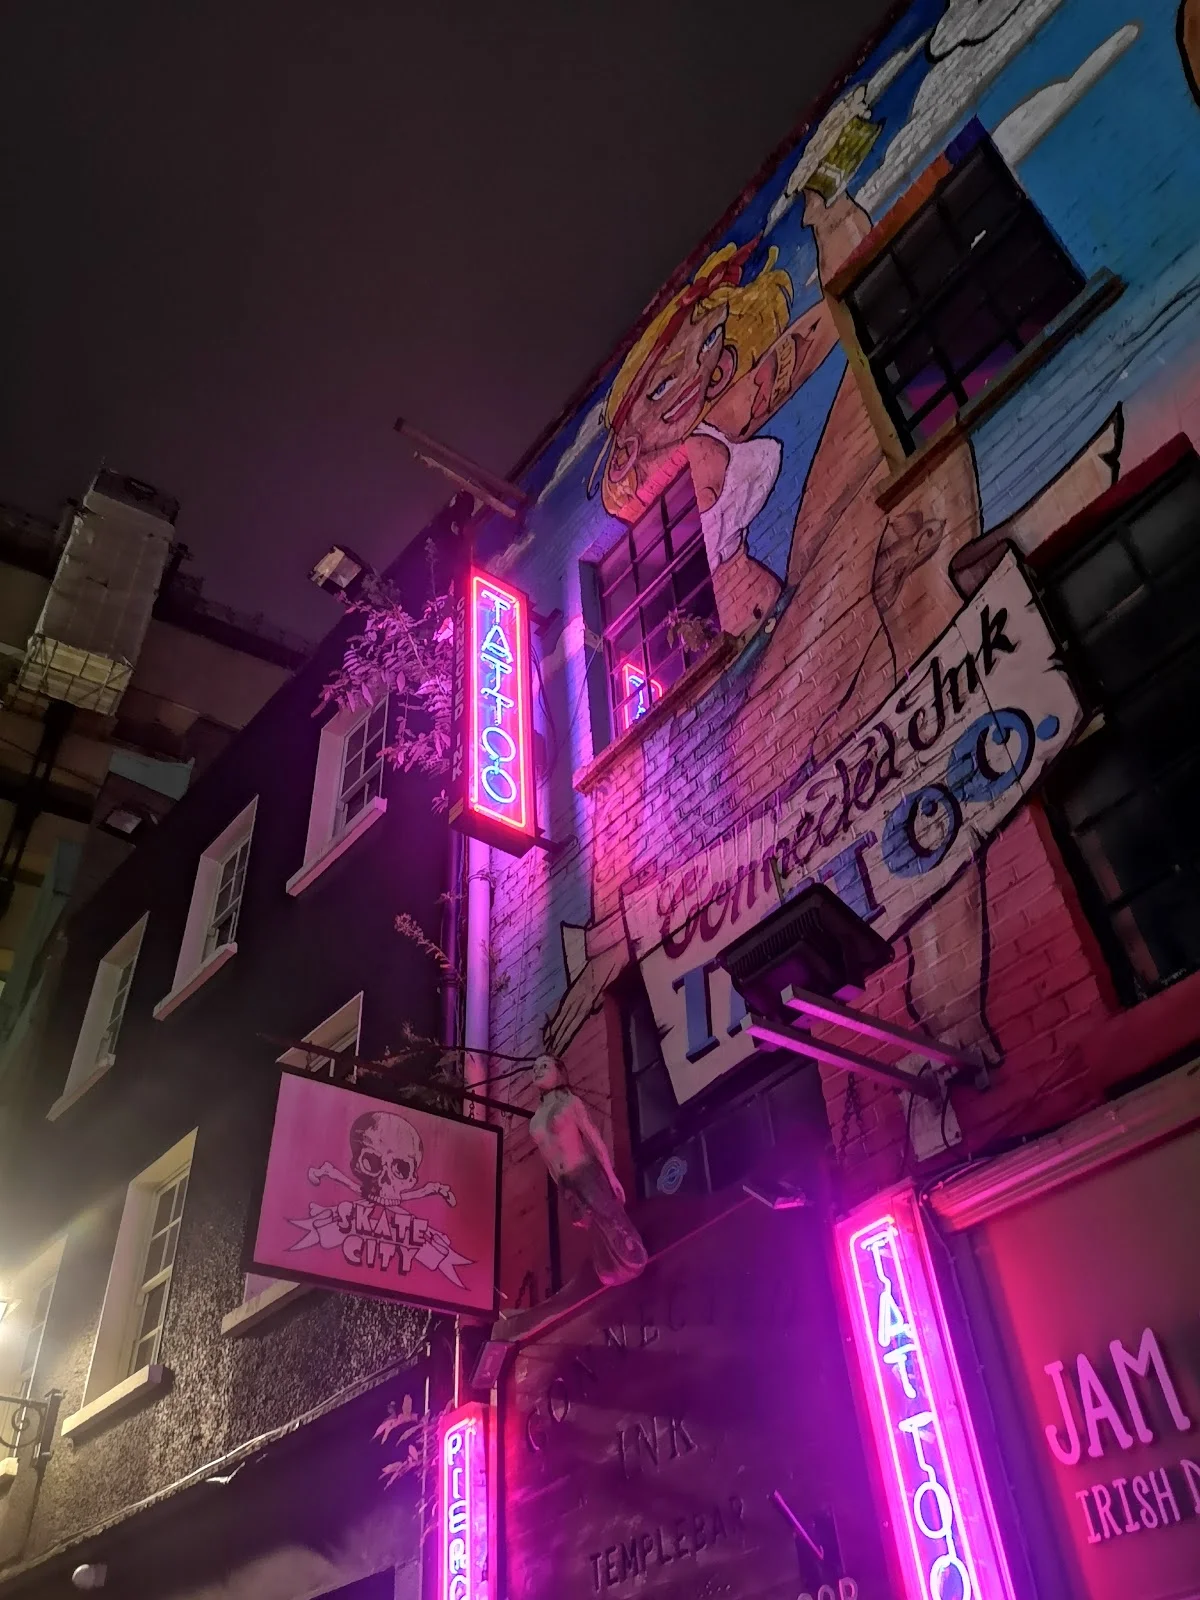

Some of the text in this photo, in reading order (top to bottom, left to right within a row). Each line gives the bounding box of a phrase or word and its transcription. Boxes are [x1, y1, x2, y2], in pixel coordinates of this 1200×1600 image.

[452, 597, 466, 782] CONNECTED INK
[480, 588, 518, 804] TATTOO
[336, 1200, 431, 1245] SKATE
[342, 1234, 420, 1276] CITY
[860, 1230, 973, 1600] TATTOO
[1044, 1326, 1191, 1466] JAM
[1075, 1467, 1181, 1544] IRISH
